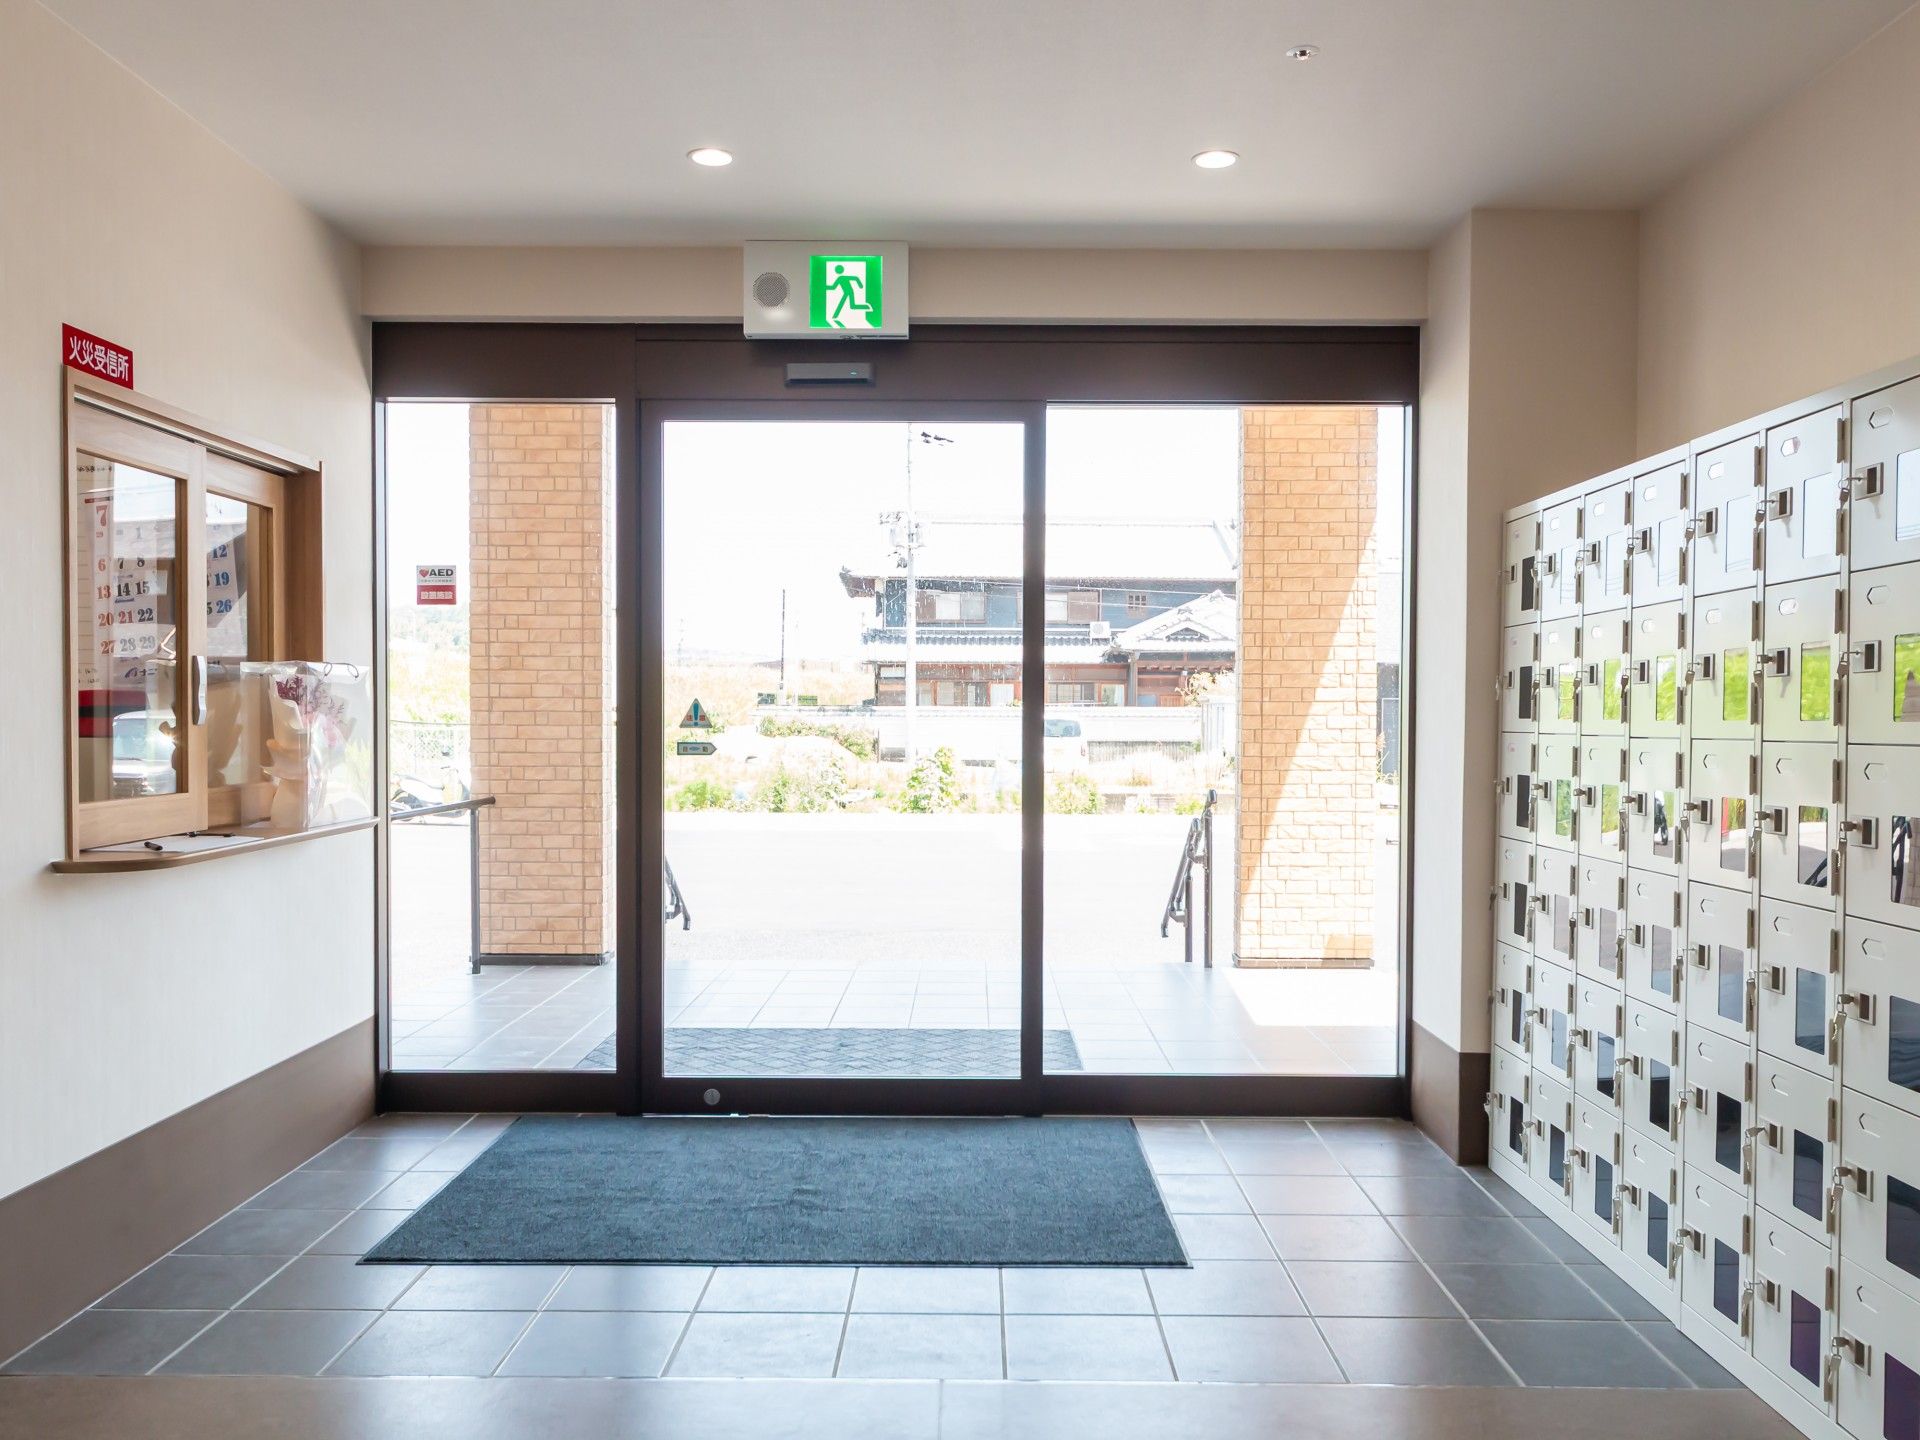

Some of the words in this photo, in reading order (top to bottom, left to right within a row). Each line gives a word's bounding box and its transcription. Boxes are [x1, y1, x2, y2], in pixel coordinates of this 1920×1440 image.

[69, 336, 129, 382] 火災受信所
[96, 504, 108, 527] 7
[98, 559, 106, 571] 6
[429, 568, 454, 577] AED
[96, 585, 112, 599] 13
[116, 583, 131, 597] 14
[135, 581, 150, 595] 15
[214, 571, 230, 586] 19
[98, 613, 114, 627] 20
[118, 611, 134, 624] 21
[137, 608, 154, 622] 22
[216, 599, 233, 614] 26
[101, 641, 116, 655] 27
[120, 638, 136, 652] 28
[139, 635, 156, 649] 29
